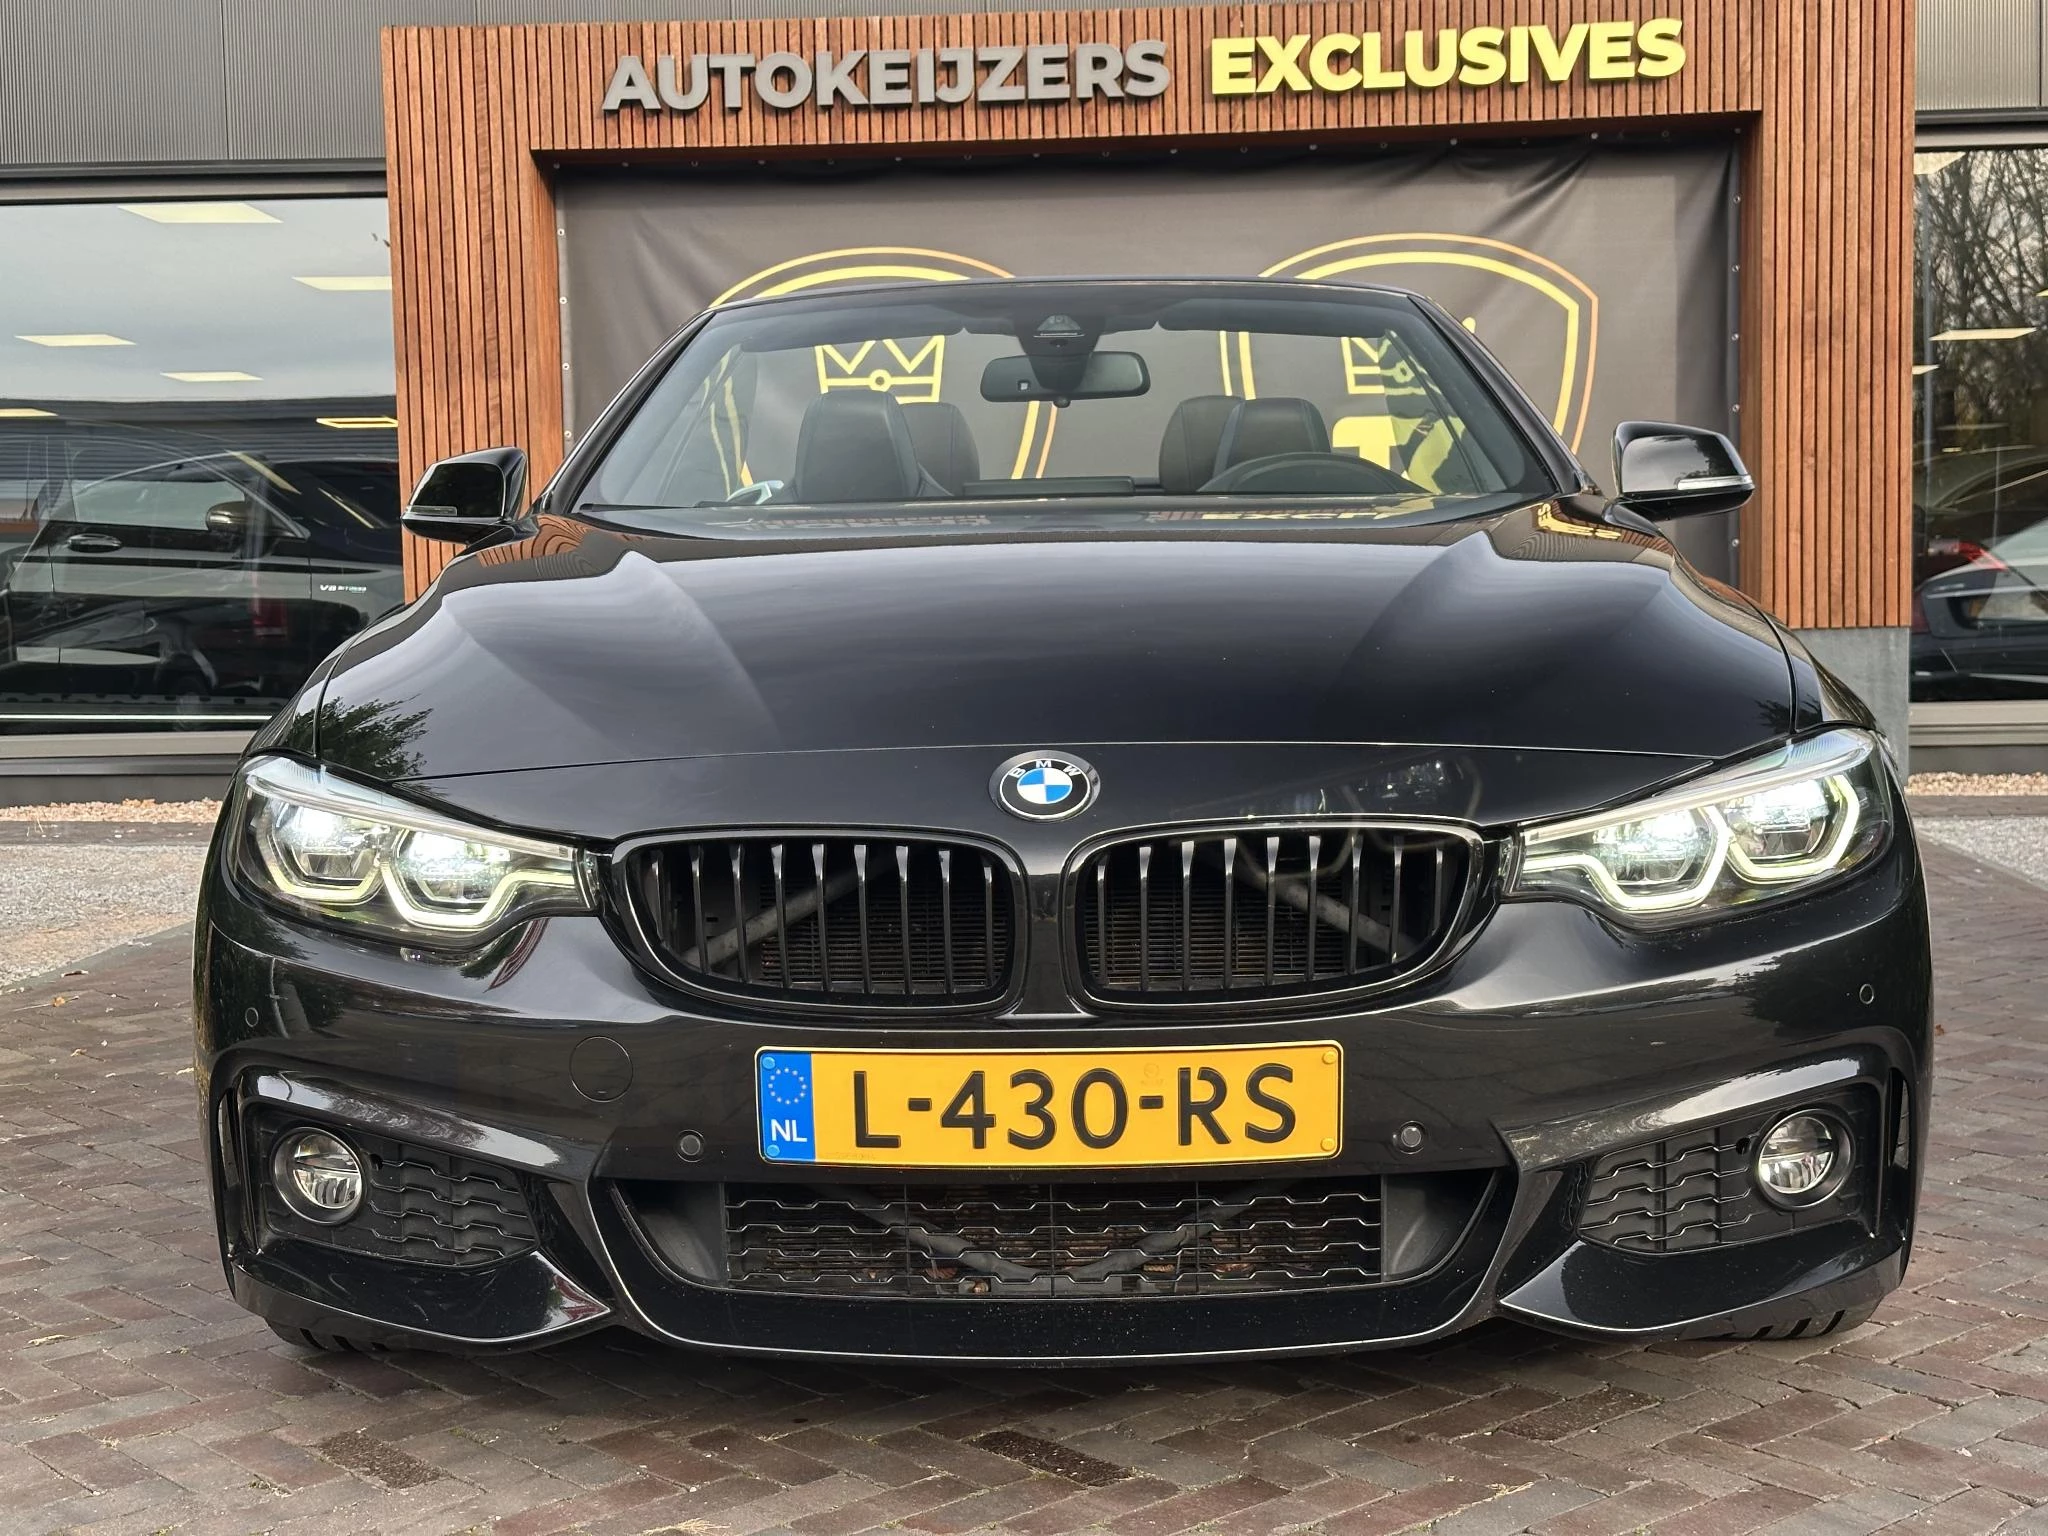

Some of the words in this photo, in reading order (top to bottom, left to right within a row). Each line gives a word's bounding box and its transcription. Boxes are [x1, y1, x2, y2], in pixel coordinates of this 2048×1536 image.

[601, 40, 1171, 112] AUTOKEIJZERS
[1210, 18, 1688, 95] EXCLUSIVES
[1008, 759, 1082, 779] BMW
[770, 1118, 808, 1143] NL
[852, 1062, 1297, 1150] L-430-RS
